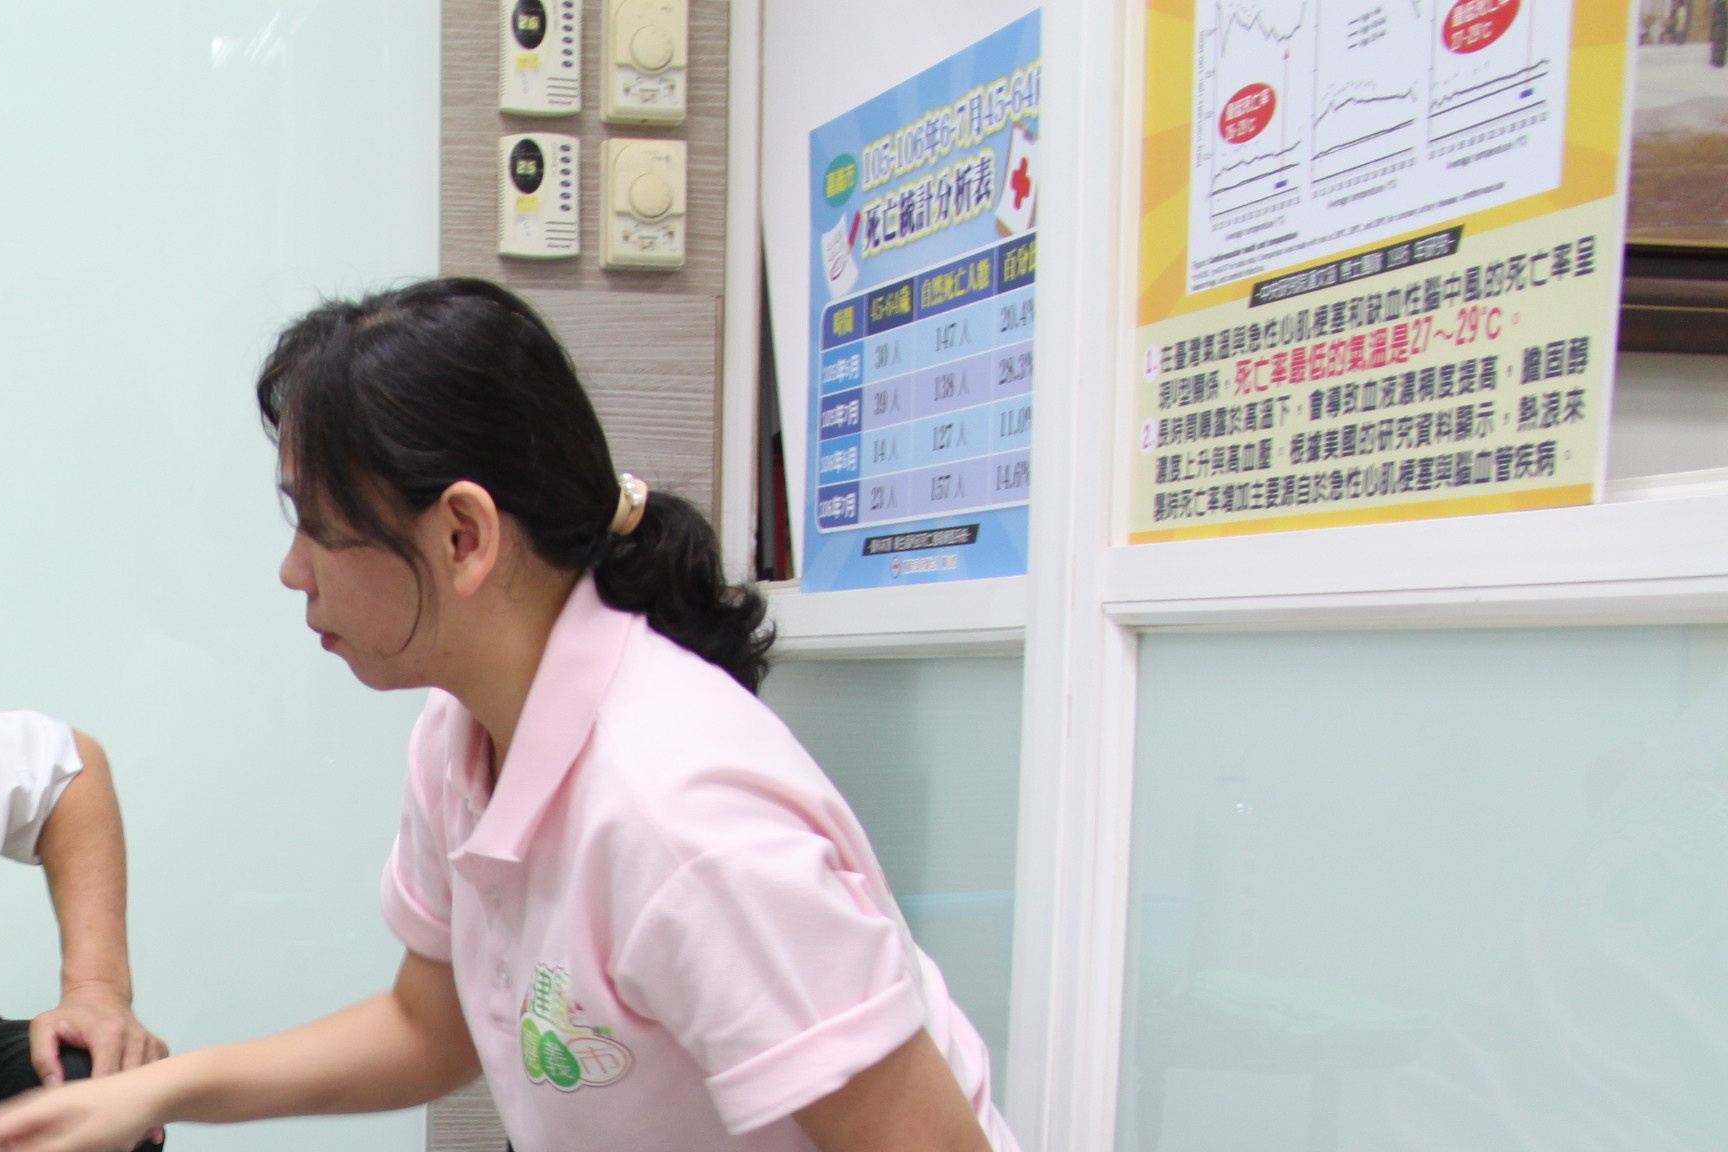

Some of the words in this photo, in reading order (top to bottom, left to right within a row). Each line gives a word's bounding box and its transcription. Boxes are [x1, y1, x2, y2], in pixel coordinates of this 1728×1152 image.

[863, 156, 992, 251] 死亡統計分析表
